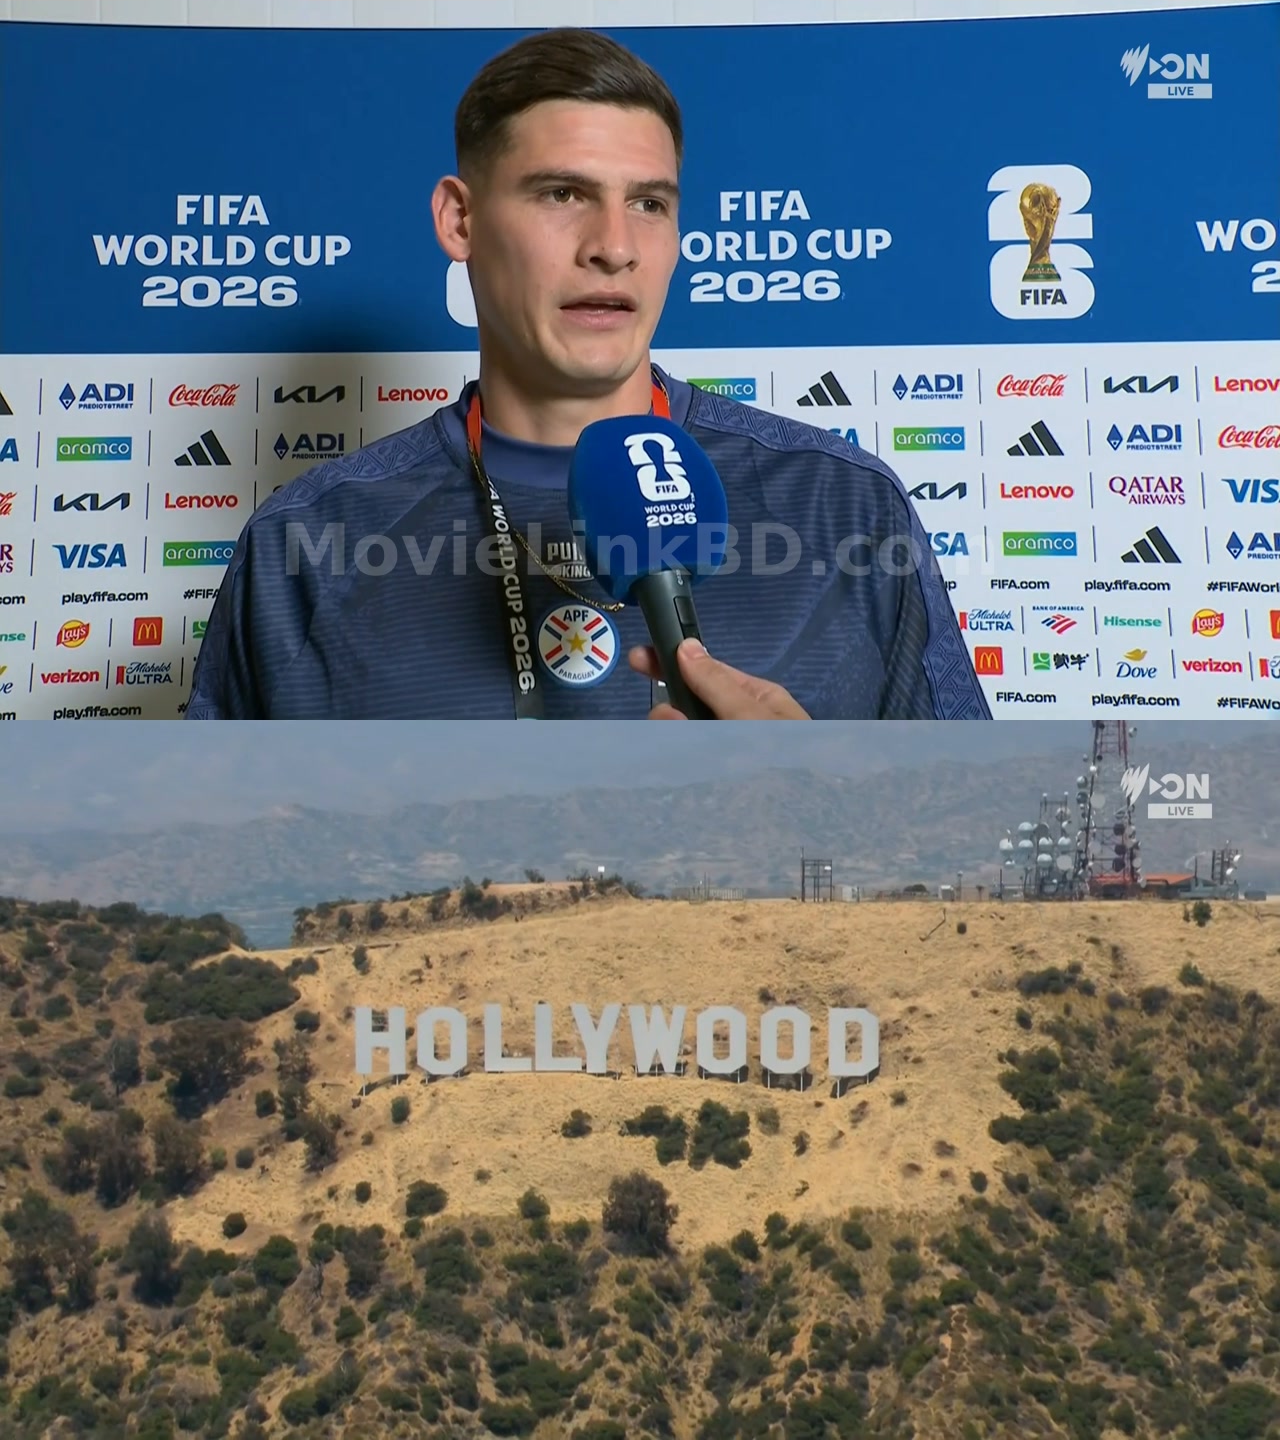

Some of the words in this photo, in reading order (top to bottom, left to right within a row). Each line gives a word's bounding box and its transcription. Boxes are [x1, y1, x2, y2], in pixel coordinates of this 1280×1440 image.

[176, 194, 270, 226] FIFA
[719, 190, 811, 222] FIFA
[92, 234, 256, 267] WORLD
[264, 234, 352, 267] CUP
[679, 230, 799, 263] ORLD
[806, 228, 893, 261] CUP
[142, 275, 298, 308] 2026
[689, 269, 842, 303] 2026
[1020, 288, 1068, 306] FIFA
[911, 374, 964, 393] ADI
[997, 374, 1068, 397] Coca-Cola
[1103, 375, 1179, 394] KIA
[1214, 375, 1280, 393] Lenov
[79, 383, 135, 402] ADI
[168, 383, 241, 407] Coca-Cola
[274, 385, 346, 404] KIA
[378, 386, 449, 402] Lenovo
[896, 433, 963, 445] aramco
[1126, 424, 1181, 443] ADI
[1218, 424, 1280, 449] Coca-Col
[59, 443, 130, 455] aramco
[292, 433, 345, 452] ADI
[655, 484, 679, 494] FIFA
[1000, 482, 1074, 499] Lenovo
[1109, 476, 1184, 497] QATAR
[1221, 478, 1280, 503] VIS
[54, 492, 131, 512] KIA
[164, 492, 238, 509] Lenovo
[1128, 494, 1186, 505] AIRWAYS
[644, 503, 678, 514] WORLD
[678, 503, 696, 512] CUP
[646, 512, 697, 528] 2026
[492, 504, 517, 571] WORLD
[1005, 538, 1075, 551] aramco
[52, 543, 127, 569] VISA
[165, 546, 235, 560] aramco
[503, 573, 524, 613] CUP
[990, 579, 1050, 590] FIFA.com
[1084, 580, 1171, 592] play.fifa.com
[1206, 581, 1280, 593] #FIFAWorl
[61, 591, 149, 605] play.fifa.com
[563, 609, 589, 622] APF
[968, 608, 1012, 620] Michelob
[1103, 616, 1162, 627] Hisense
[970, 621, 1015, 632] ULTRA
[1195, 615, 1222, 631] Lay's
[61, 624, 88, 643] Lay's
[510, 616, 536, 691] 2026
[126, 662, 171, 675] Michelob
[558, 668, 596, 680] PARAGUAY
[1116, 661, 1158, 679] Dove
[1182, 658, 1243, 673] verizon
[41, 669, 99, 684] verizon
[127, 674, 173, 685] ULTRA
[996, 691, 1057, 703] FIFA.com
[1092, 694, 1180, 707] play.fifa.com
[1216, 697, 1280, 710] #FIFAWo
[53, 705, 142, 720] play.fifa.com
[354, 1003, 880, 1078] HOLLYWOOD
